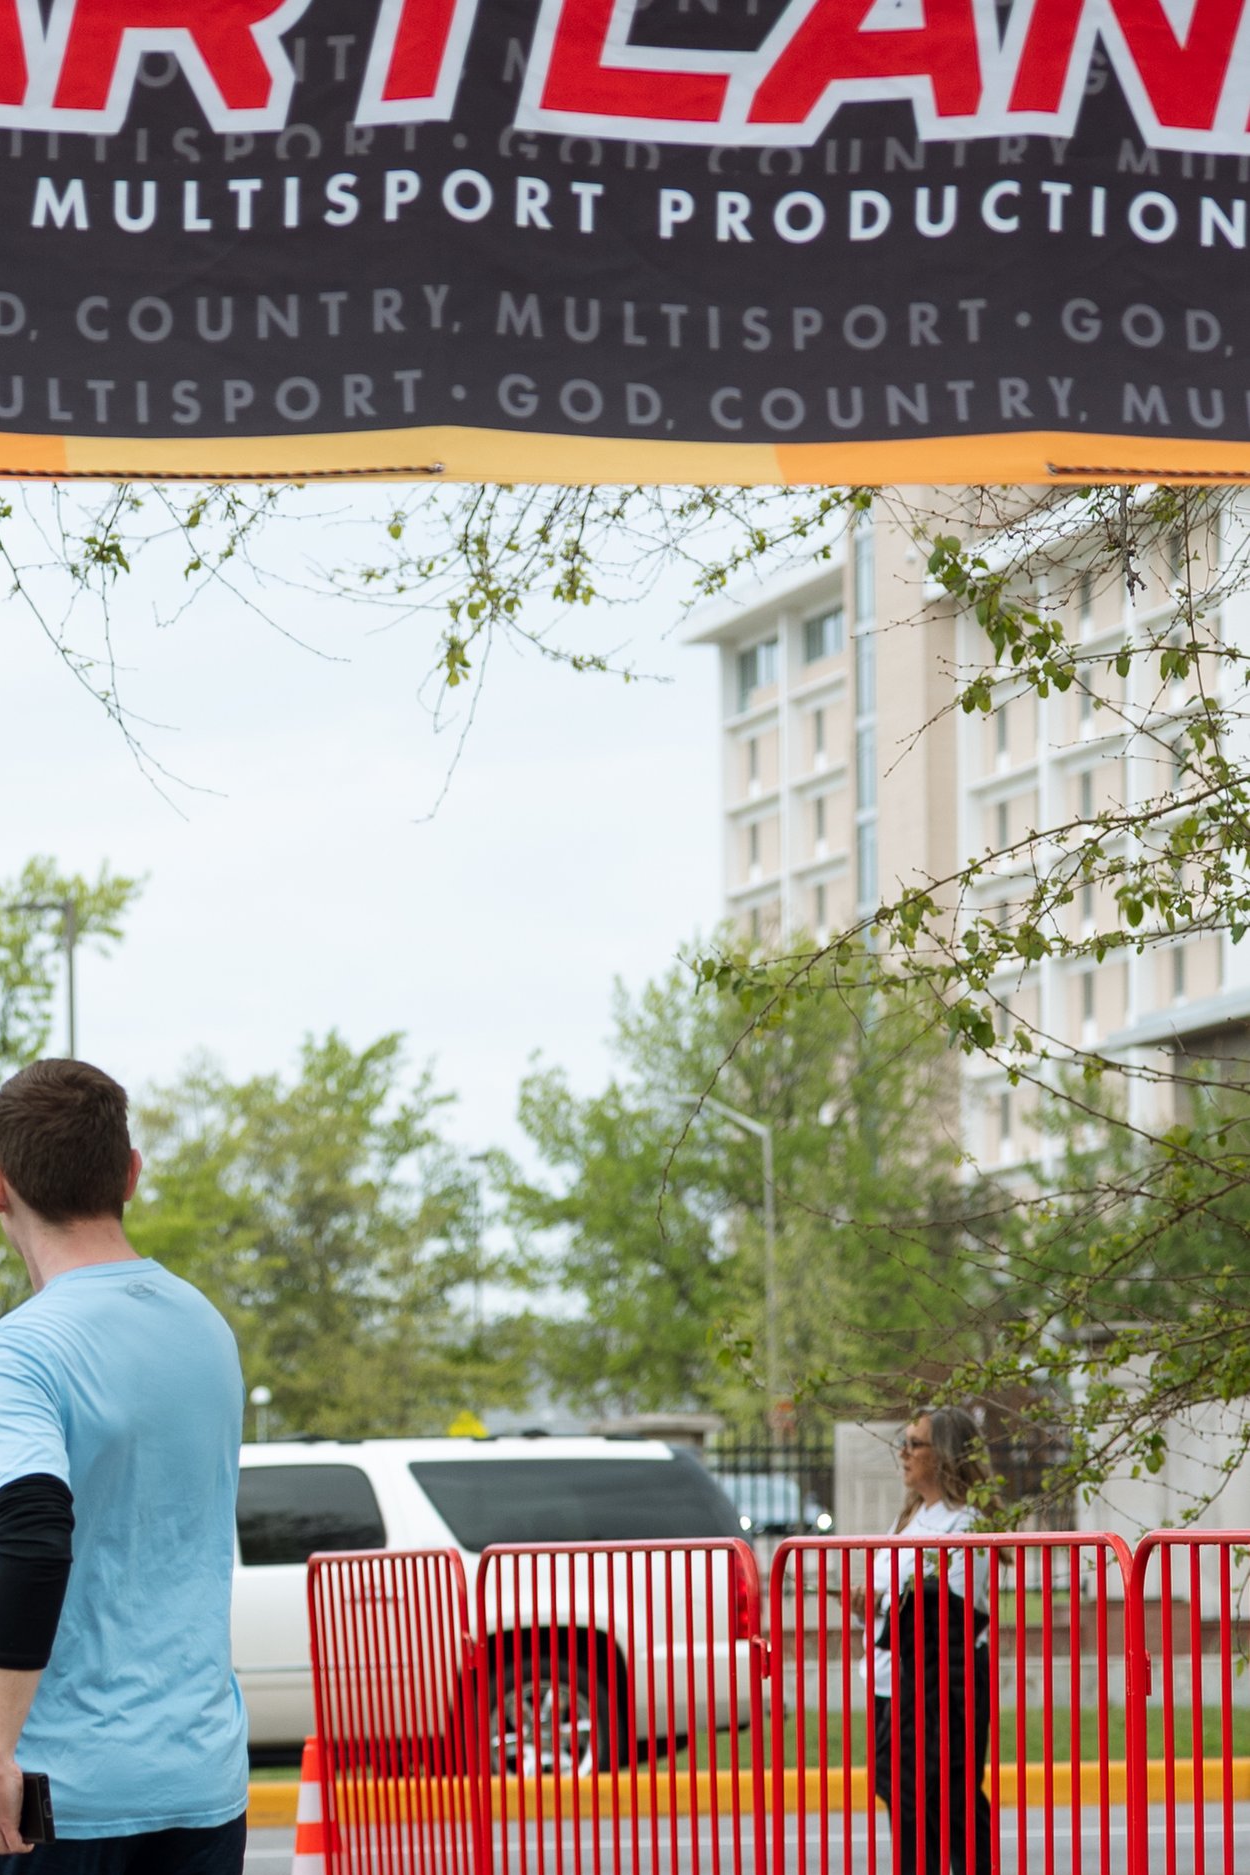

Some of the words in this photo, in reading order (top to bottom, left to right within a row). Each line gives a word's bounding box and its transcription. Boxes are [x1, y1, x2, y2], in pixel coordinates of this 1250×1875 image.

[31, 168, 604, 234] MULTISPORT
[659, 179, 1247, 249] PRODUCTION
[76, 284, 461, 342] COUNTRY,
[496, 290, 987, 350] MULTISPORT
[1061, 298, 1234, 357] GOD,
[497, 373, 675, 430] GOD,
[710, 377, 1088, 431] COUNTRY,
[1122, 383, 1250, 429] MU
